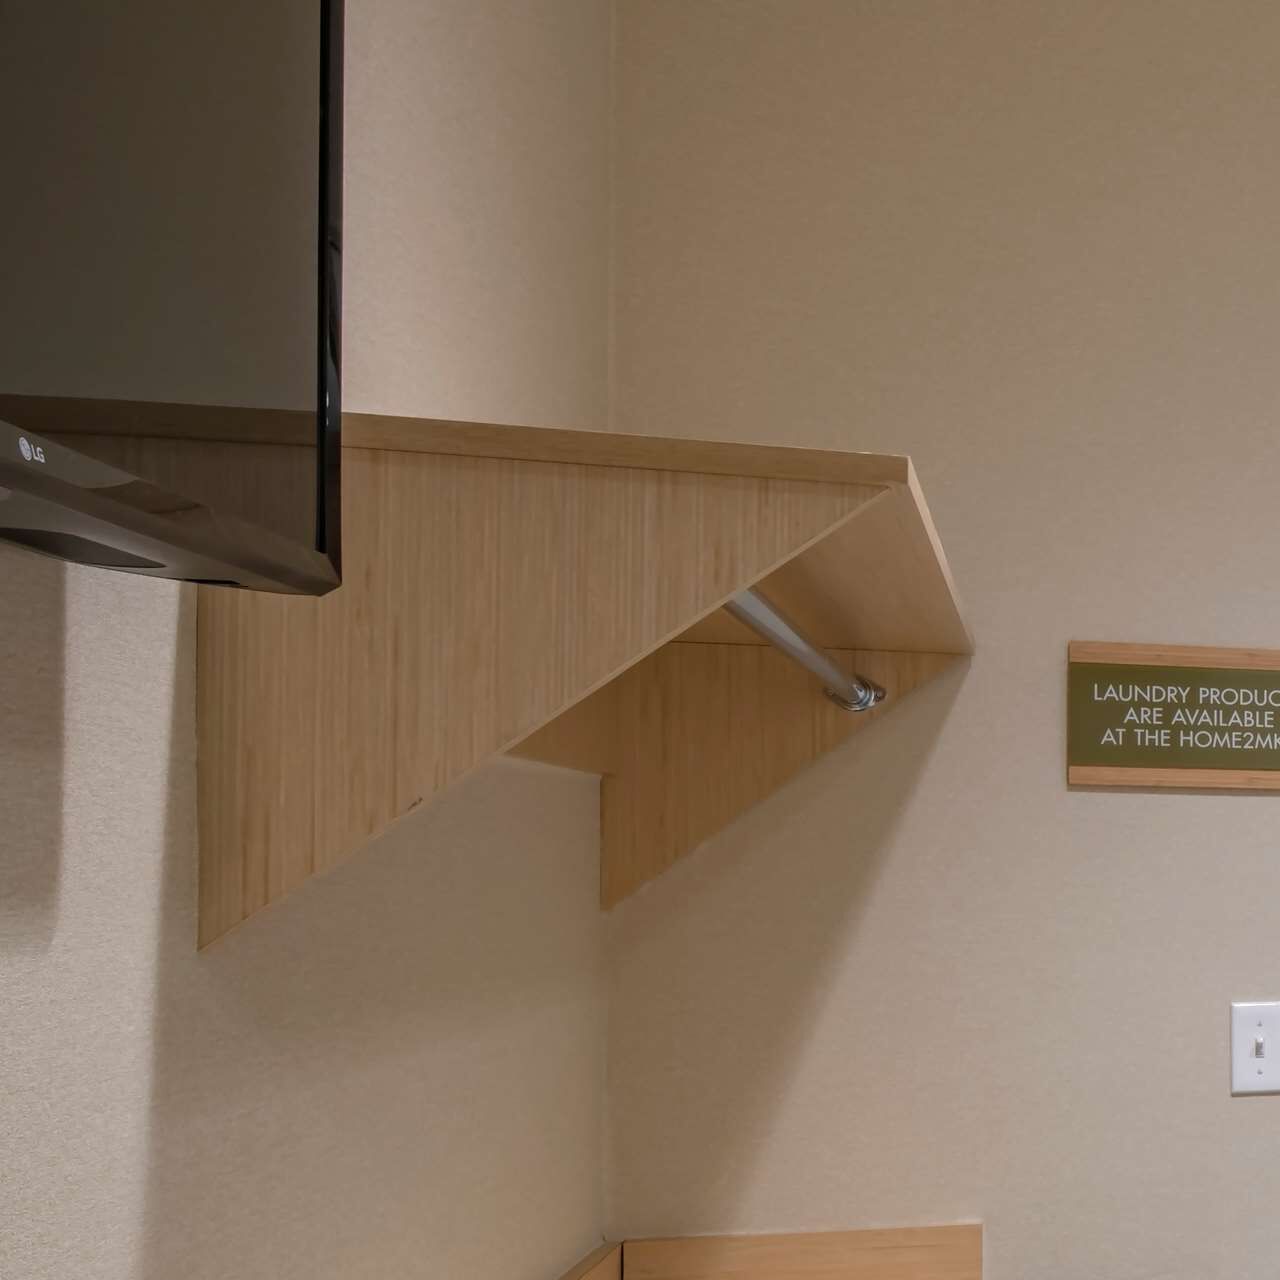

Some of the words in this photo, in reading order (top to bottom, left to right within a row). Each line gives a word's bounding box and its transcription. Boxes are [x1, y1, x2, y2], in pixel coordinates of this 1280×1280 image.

[31, 444, 46, 464] LG
[1094, 683, 1191, 703] LAUNDRY
[1123, 707, 1163, 724] ARE
[1171, 708, 1275, 728] AVAILABLE
[1100, 728, 1126, 745] AT
[1134, 729, 1171, 746] THE
